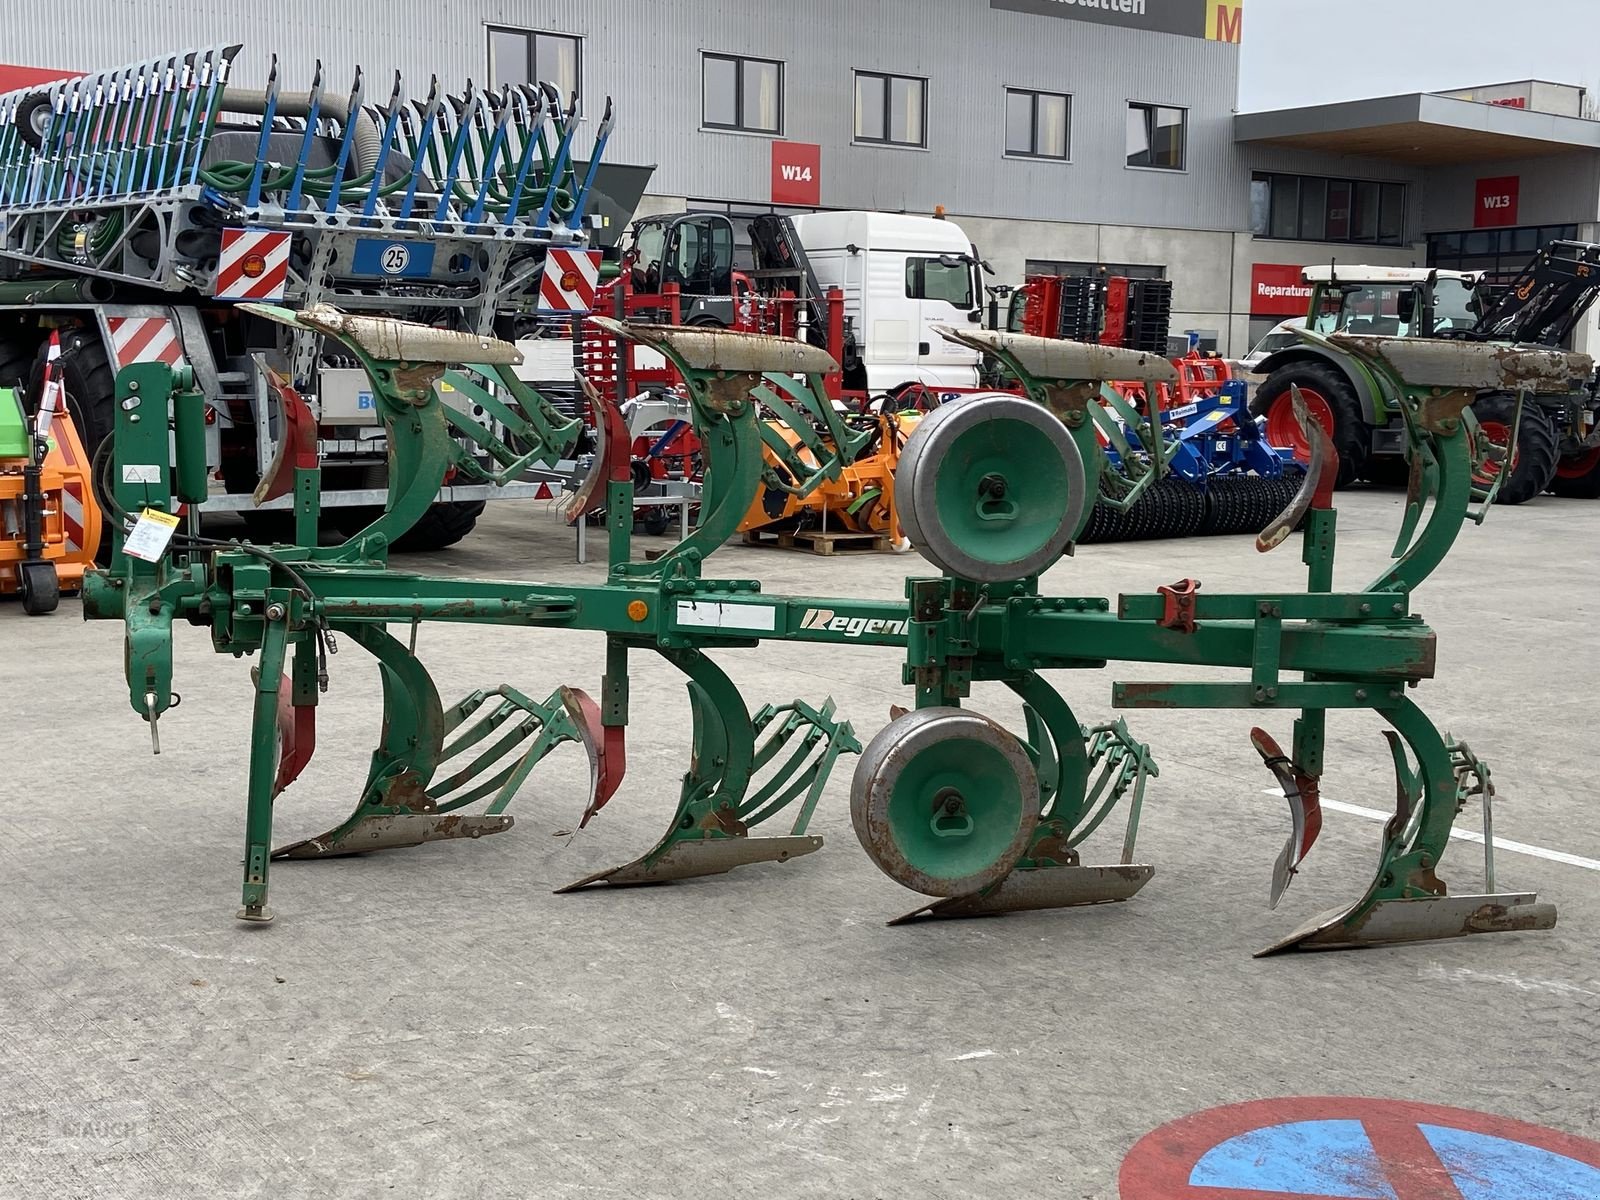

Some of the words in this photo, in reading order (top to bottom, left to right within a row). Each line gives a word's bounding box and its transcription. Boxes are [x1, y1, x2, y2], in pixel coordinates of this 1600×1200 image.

[781, 165, 812, 182] W14
[1483, 195, 1510, 209] W13
[386, 249, 405, 268] 25
